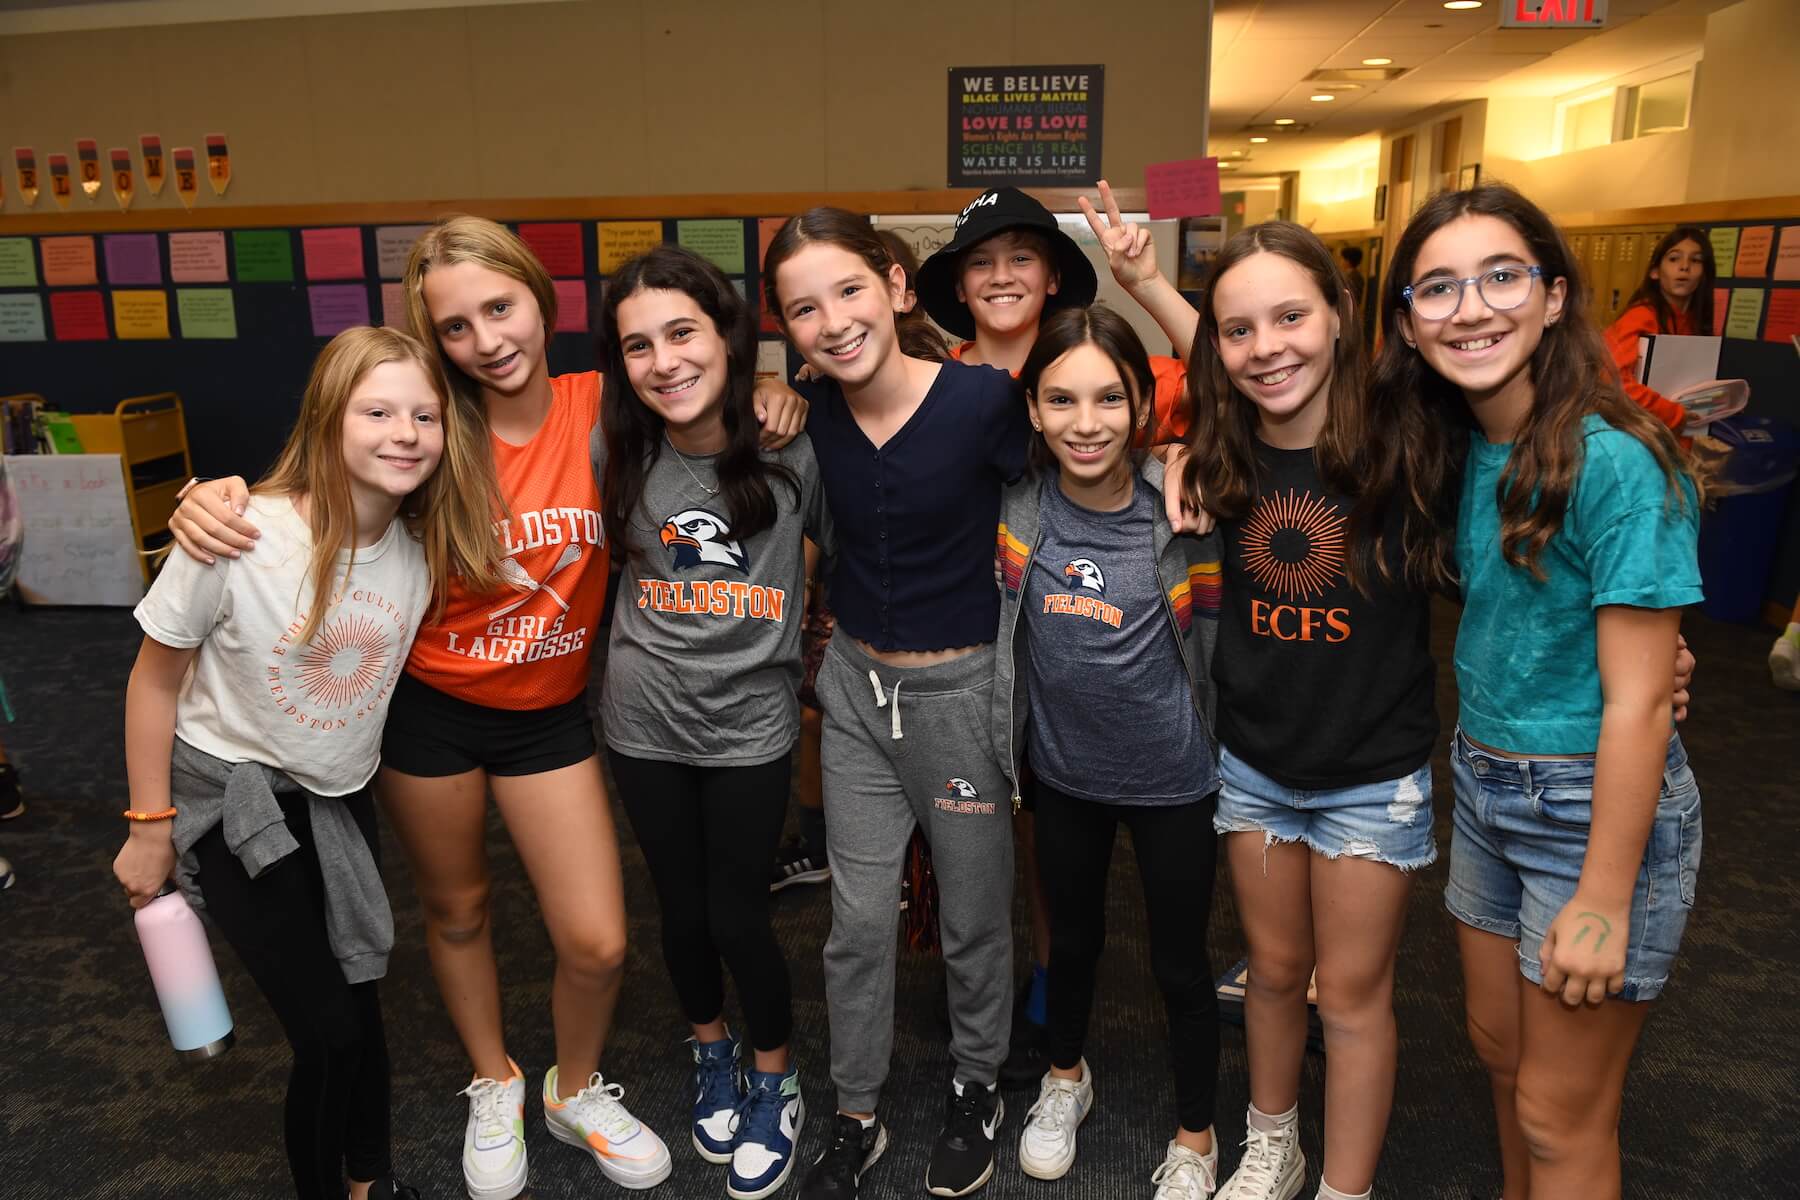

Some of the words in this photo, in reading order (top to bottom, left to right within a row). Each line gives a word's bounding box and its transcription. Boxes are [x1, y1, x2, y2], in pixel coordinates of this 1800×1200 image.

[963, 77, 993, 92] WE
[1004, 75, 1089, 92] BELIEVE
[962, 93, 999, 104] BLACK
[1004, 92, 1036, 103] LIVES
[1041, 92, 1088, 102] MATTER
[962, 116, 1008, 130] LOVE
[1016, 116, 1033, 129] IS
[1040, 115, 1088, 129] LOVE
[962, 143, 1024, 155] SCIENCE
[1032, 143, 1044, 154] IS
[1051, 142, 1087, 154] REAL
[962, 157, 1017, 167] WATER
[1027, 156, 1042, 166] IS
[1052, 156, 1087, 166] LIFE
[637, 579, 785, 623] FIELDSTON
[1043, 594, 1124, 629] FIELDSTON
[486, 613, 567, 640] GIRLS
[1250, 599, 1352, 643] ECFS
[446, 627, 588, 665] LACROSSE
[933, 797, 996, 815] FIELDSTON
